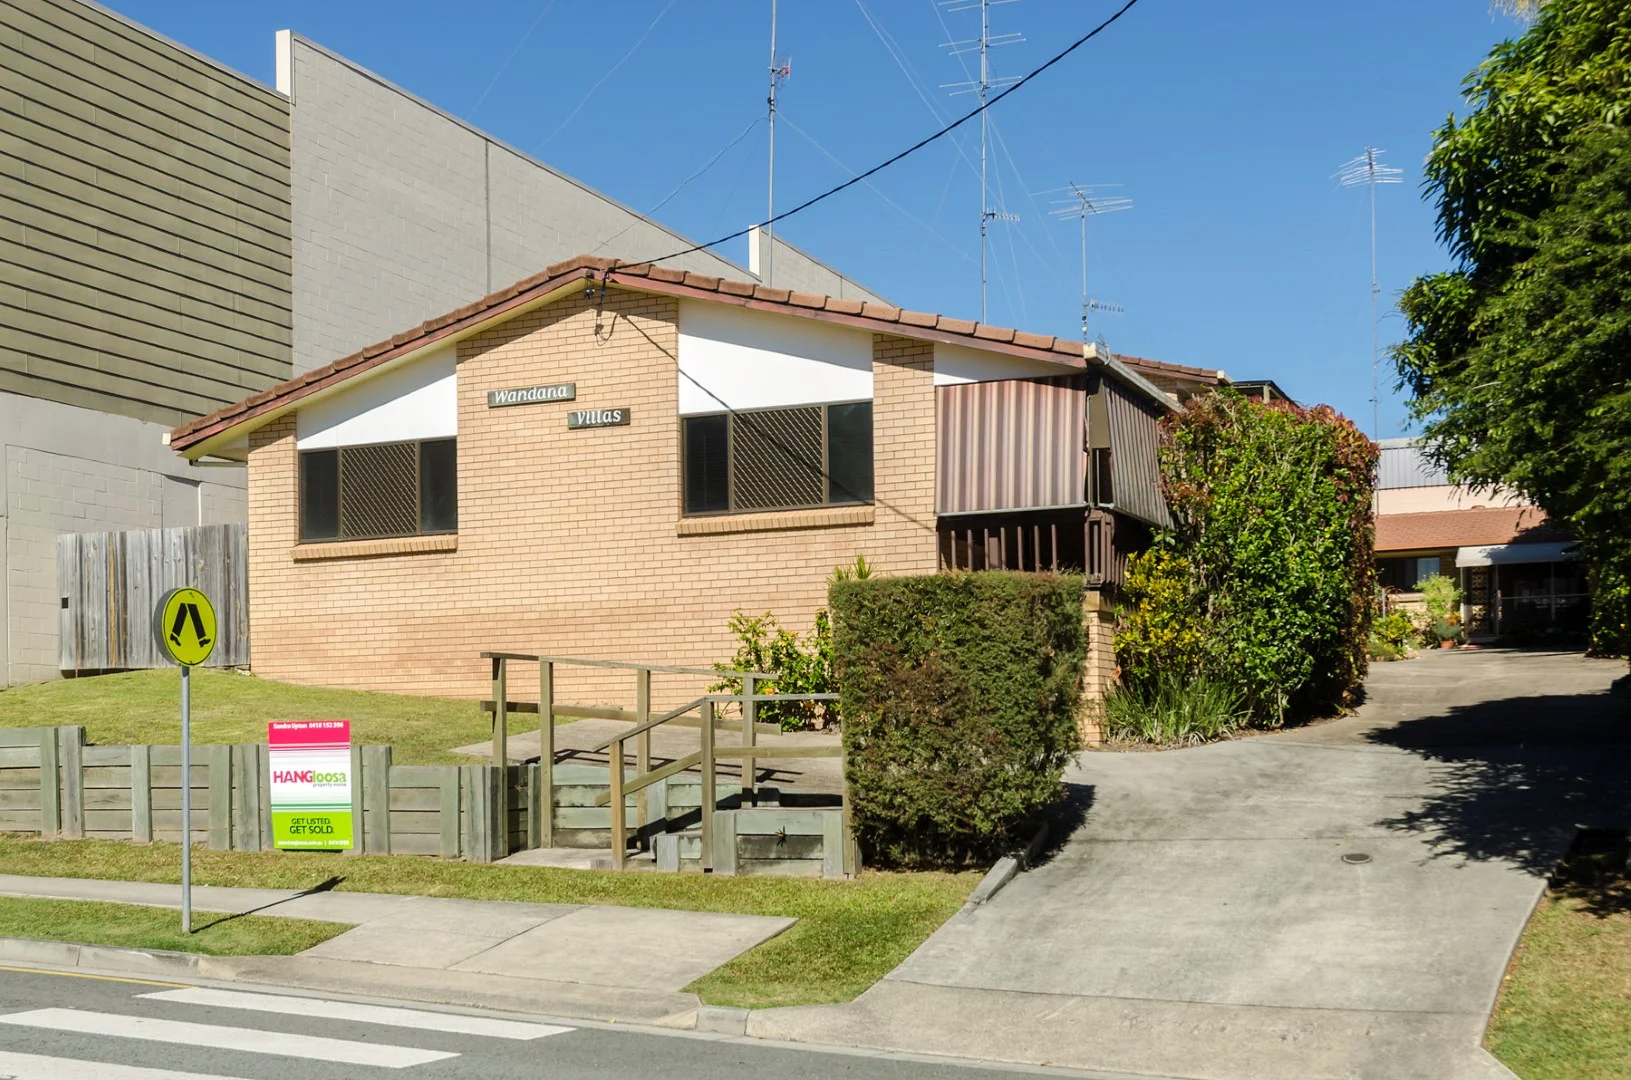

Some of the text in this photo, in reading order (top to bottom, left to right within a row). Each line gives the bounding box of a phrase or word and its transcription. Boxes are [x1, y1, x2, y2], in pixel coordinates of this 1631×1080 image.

[494, 386, 568, 404] Wandana
[577, 409, 621, 425] Villas
[289, 825, 334, 834] GET SOLD.
